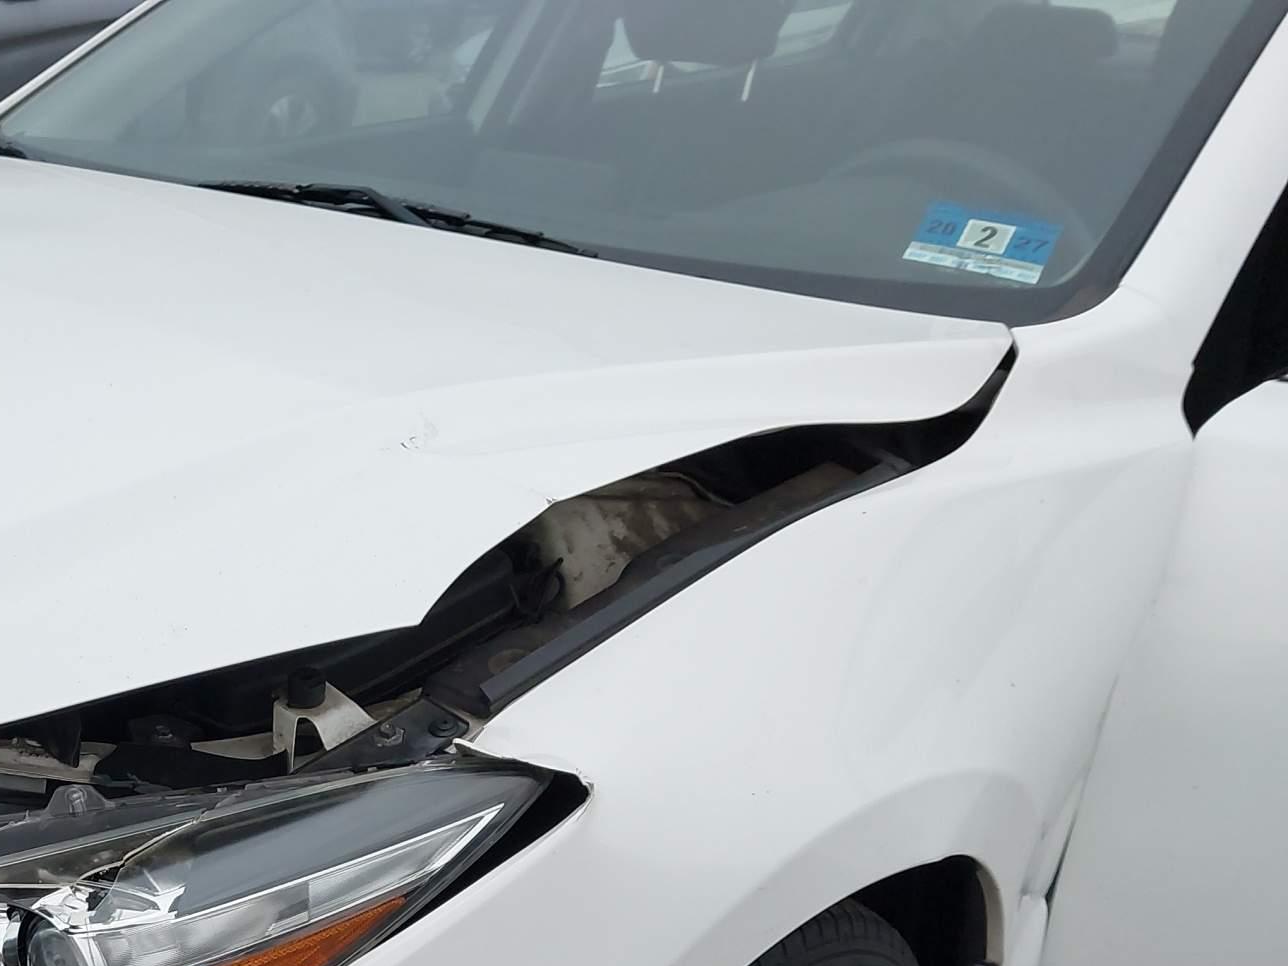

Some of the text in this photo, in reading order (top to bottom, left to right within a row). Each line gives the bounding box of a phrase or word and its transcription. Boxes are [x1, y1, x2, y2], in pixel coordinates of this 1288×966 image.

[926, 219, 1049, 253] 20 2 27
